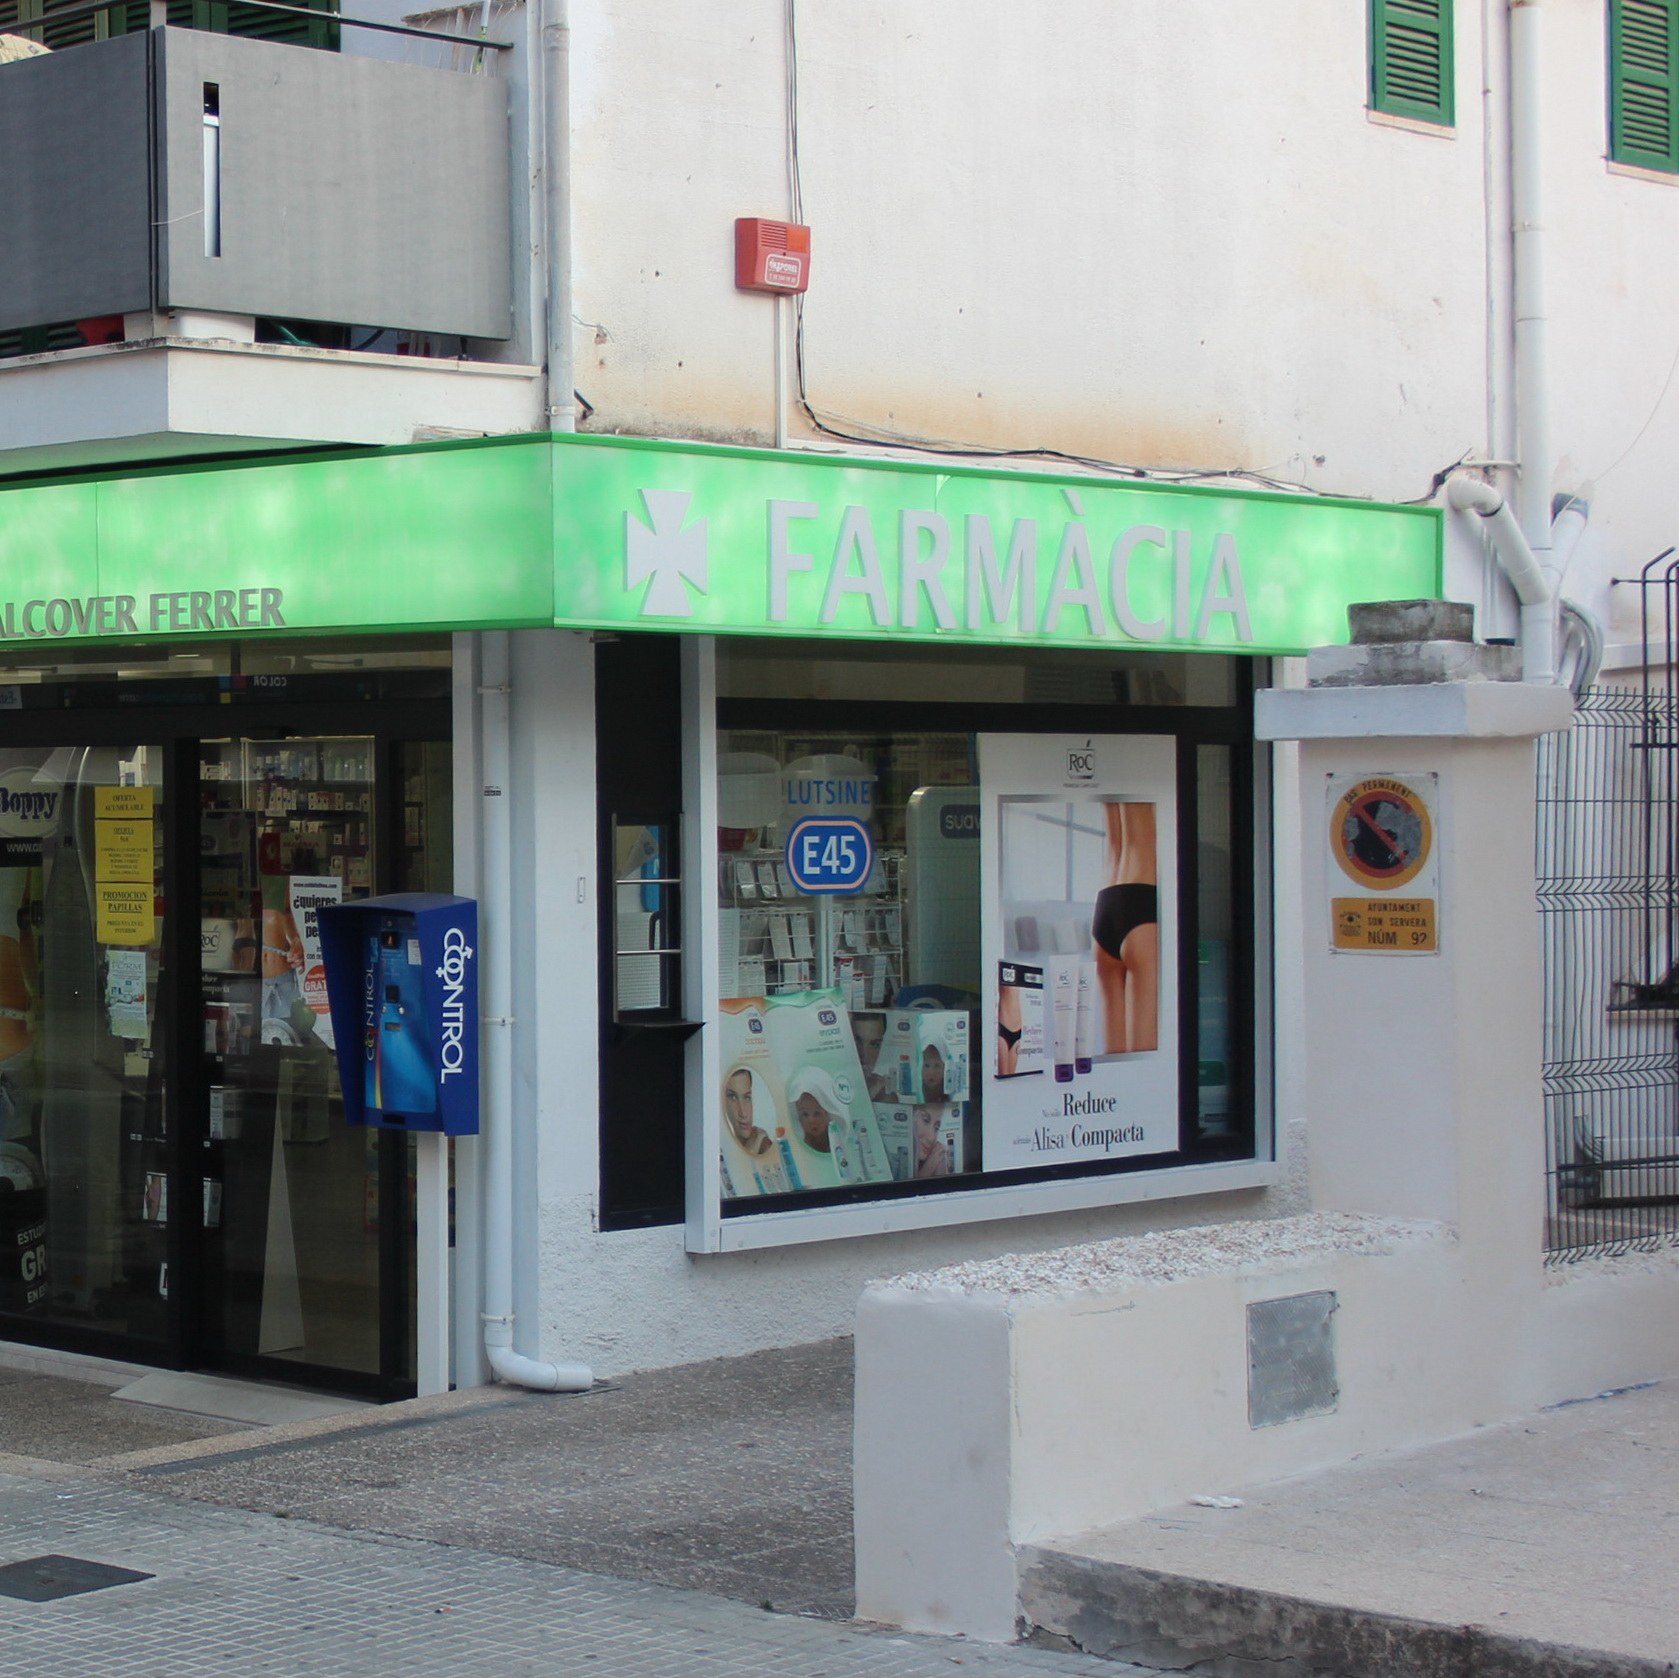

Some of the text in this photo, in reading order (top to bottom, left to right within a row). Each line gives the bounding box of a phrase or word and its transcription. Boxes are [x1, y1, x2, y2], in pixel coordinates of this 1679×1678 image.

[767, 489, 1252, 642] FARMÀCIA
[149, 588, 286, 632] FERRER
[787, 780, 869, 804] LUTSINE
[803, 835, 856, 875] E45
[103, 891, 147, 900] PROMOCION
[108, 903, 142, 911] PAPILLAS
[1390, 917, 1426, 927] SERVERA
[1368, 928, 1397, 944] NÚM
[1063, 1091, 1116, 1116] Reduce
[1071, 1121, 1144, 1152] Compacta
